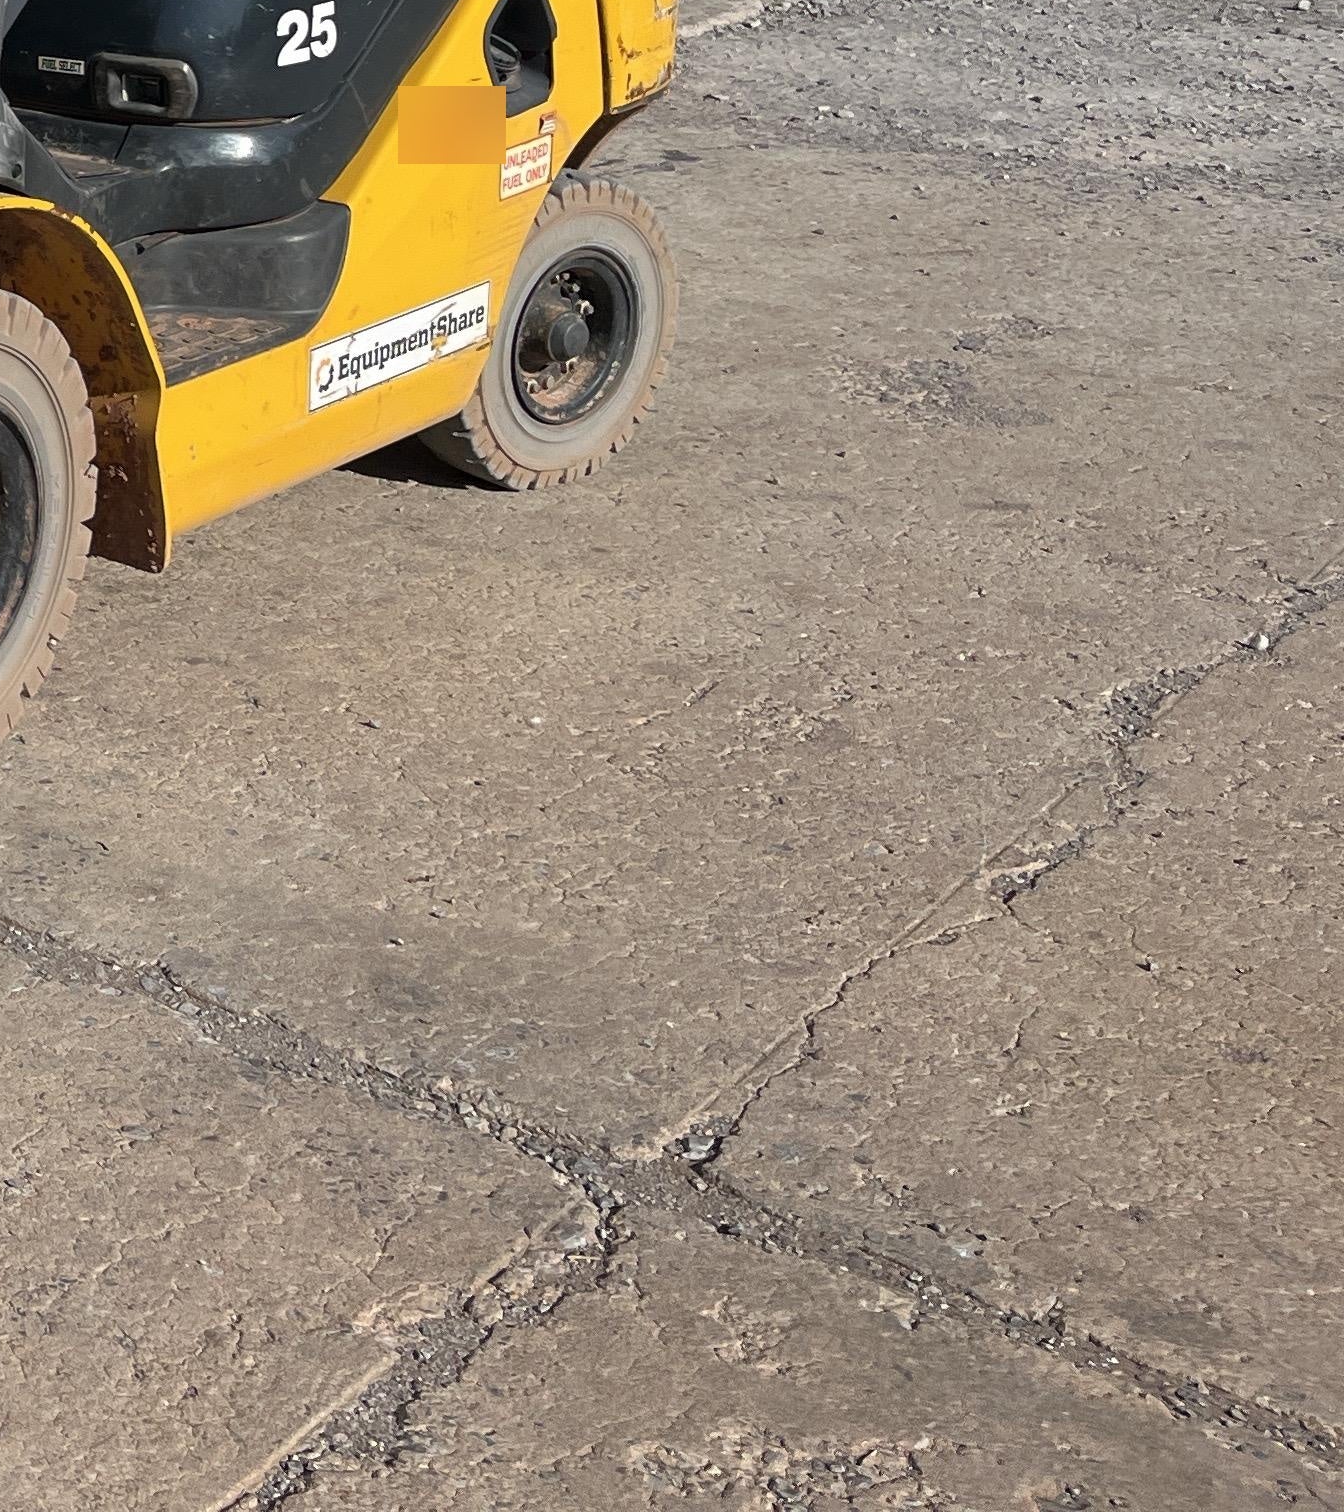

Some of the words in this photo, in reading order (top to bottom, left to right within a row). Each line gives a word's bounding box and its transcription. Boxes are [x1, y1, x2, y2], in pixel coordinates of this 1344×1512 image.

[276, 0, 338, 67] 25
[502, 173, 523, 192] FUEL
[525, 163, 548, 183] ONLY
[338, 305, 485, 380] EquipmentShare
